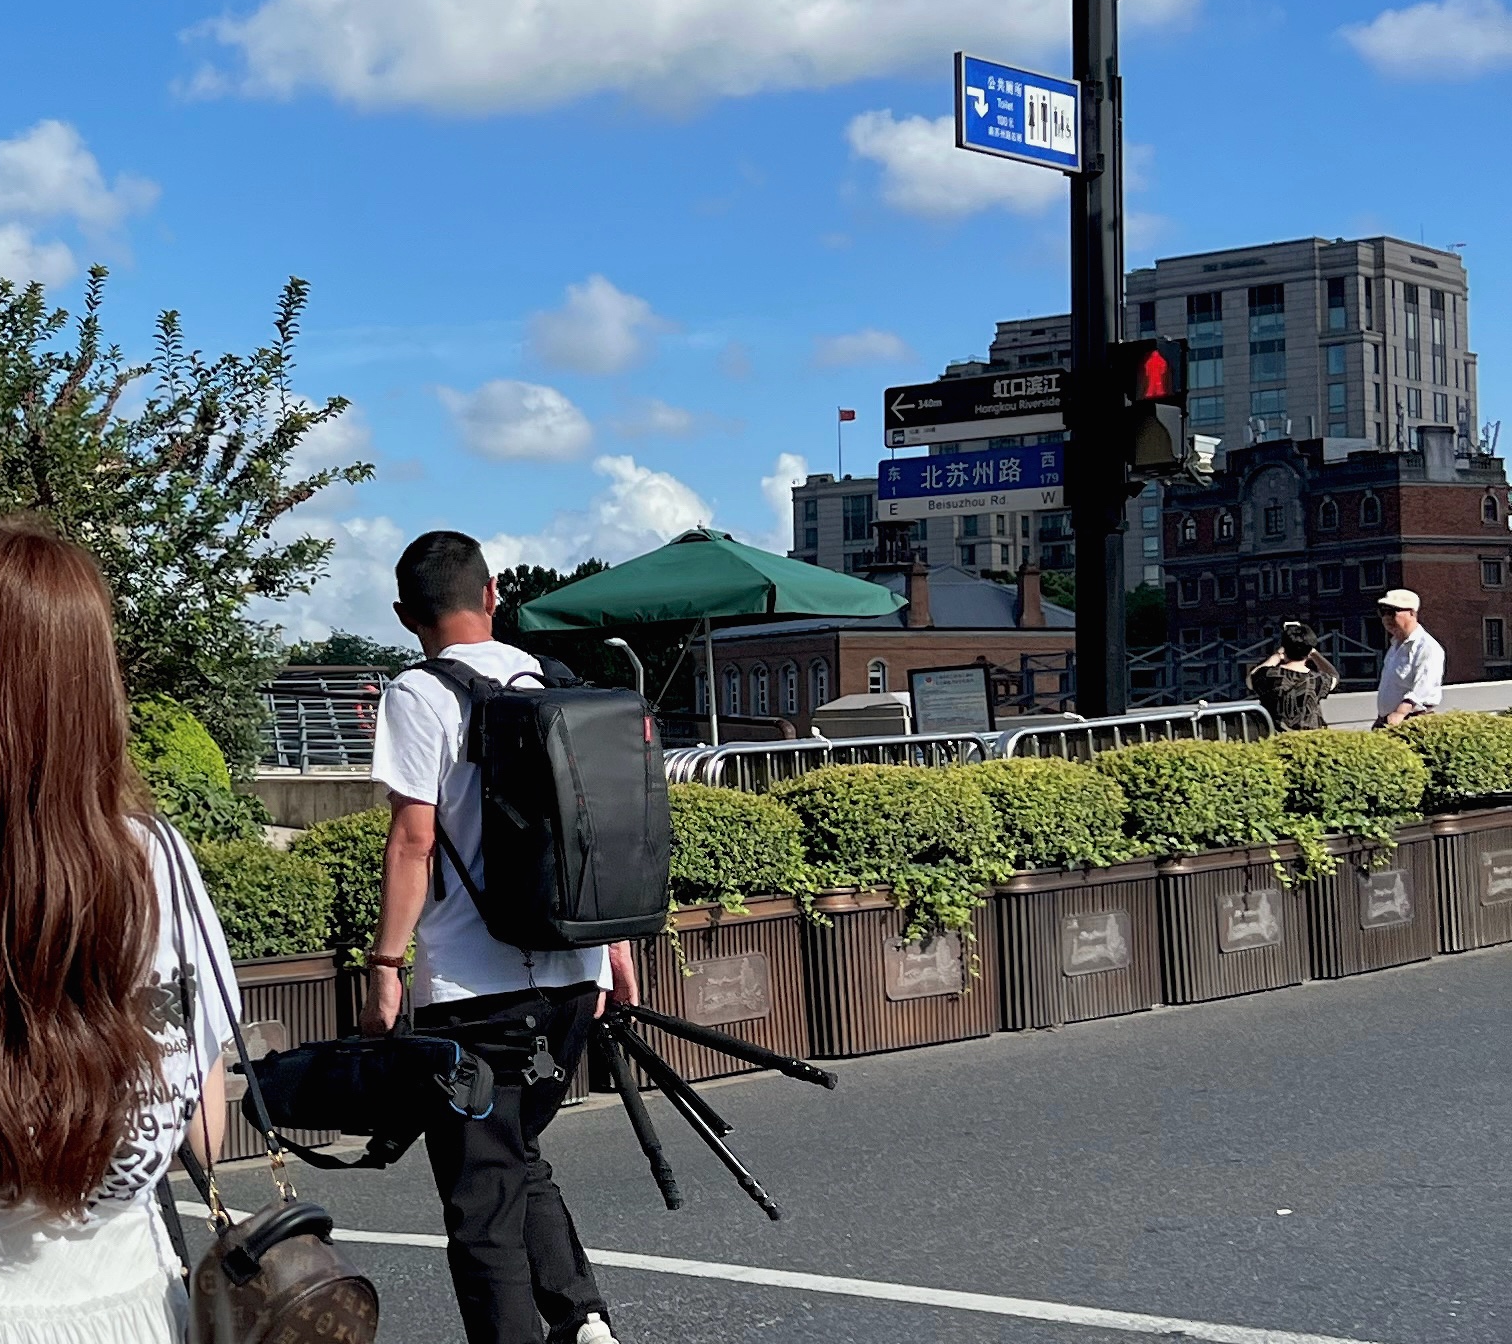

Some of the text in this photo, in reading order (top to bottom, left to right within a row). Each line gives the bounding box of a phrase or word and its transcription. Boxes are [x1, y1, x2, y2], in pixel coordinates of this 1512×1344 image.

[993, 374, 1061, 397] 虹口滨江
[975, 397, 1061, 414] Hongkou Riverside
[1040, 451, 1056, 468] 西
[888, 466, 902, 482] 东
[920, 457, 1023, 490] 北苏州路
[1040, 472, 1059, 485] 179
[928, 497, 986, 511] Beisuzhou
[1041, 491, 1056, 504] W
[889, 502, 899, 516] E
